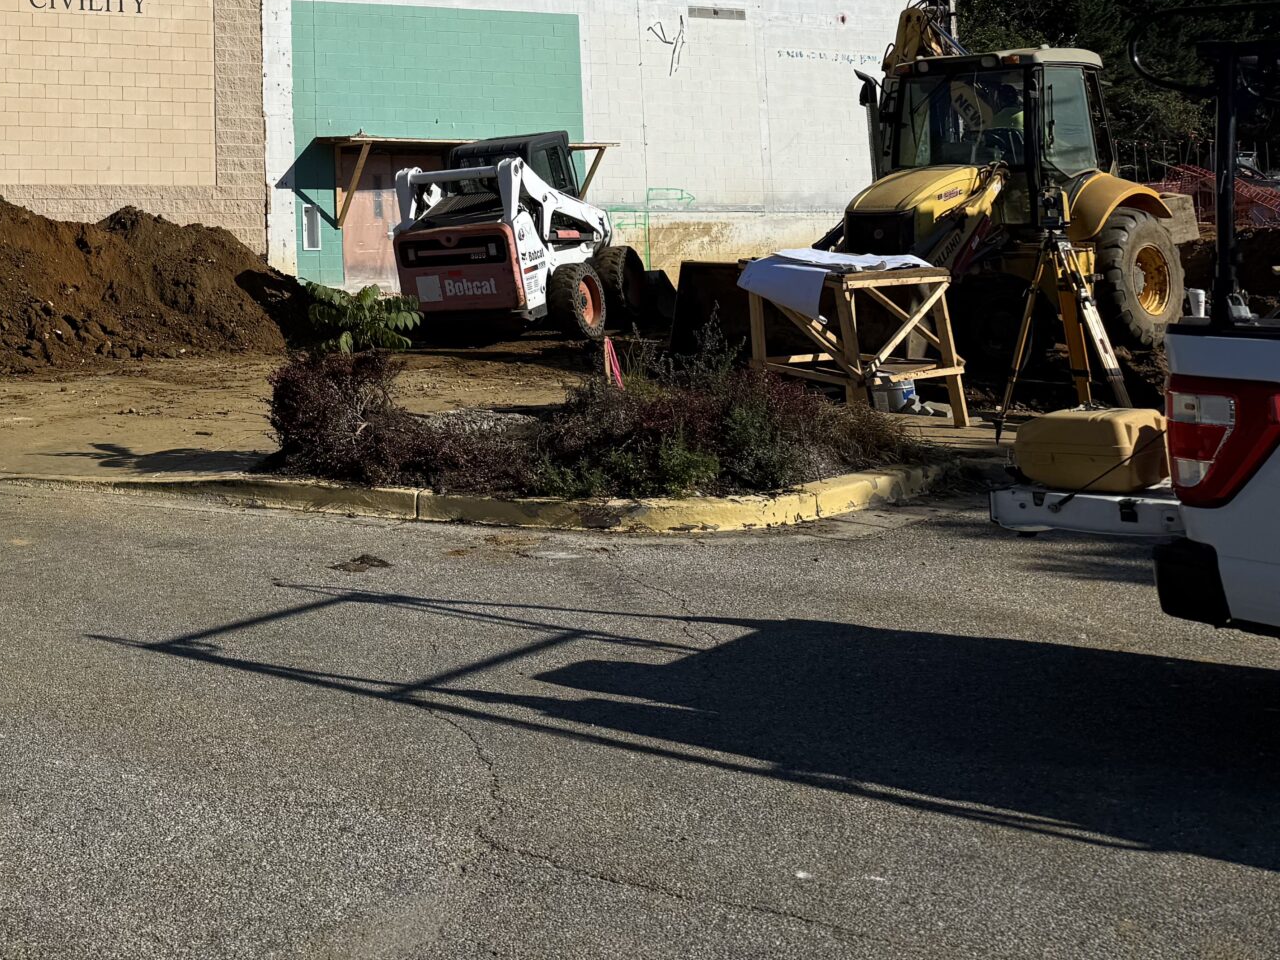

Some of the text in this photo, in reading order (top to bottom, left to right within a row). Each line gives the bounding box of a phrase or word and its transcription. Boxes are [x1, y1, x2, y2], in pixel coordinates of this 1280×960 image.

[955, 94, 986, 127] NEW
[528, 248, 545, 262] Bobcat
[934, 232, 961, 267] OLLAND
[444, 277, 497, 297] Bobcat
